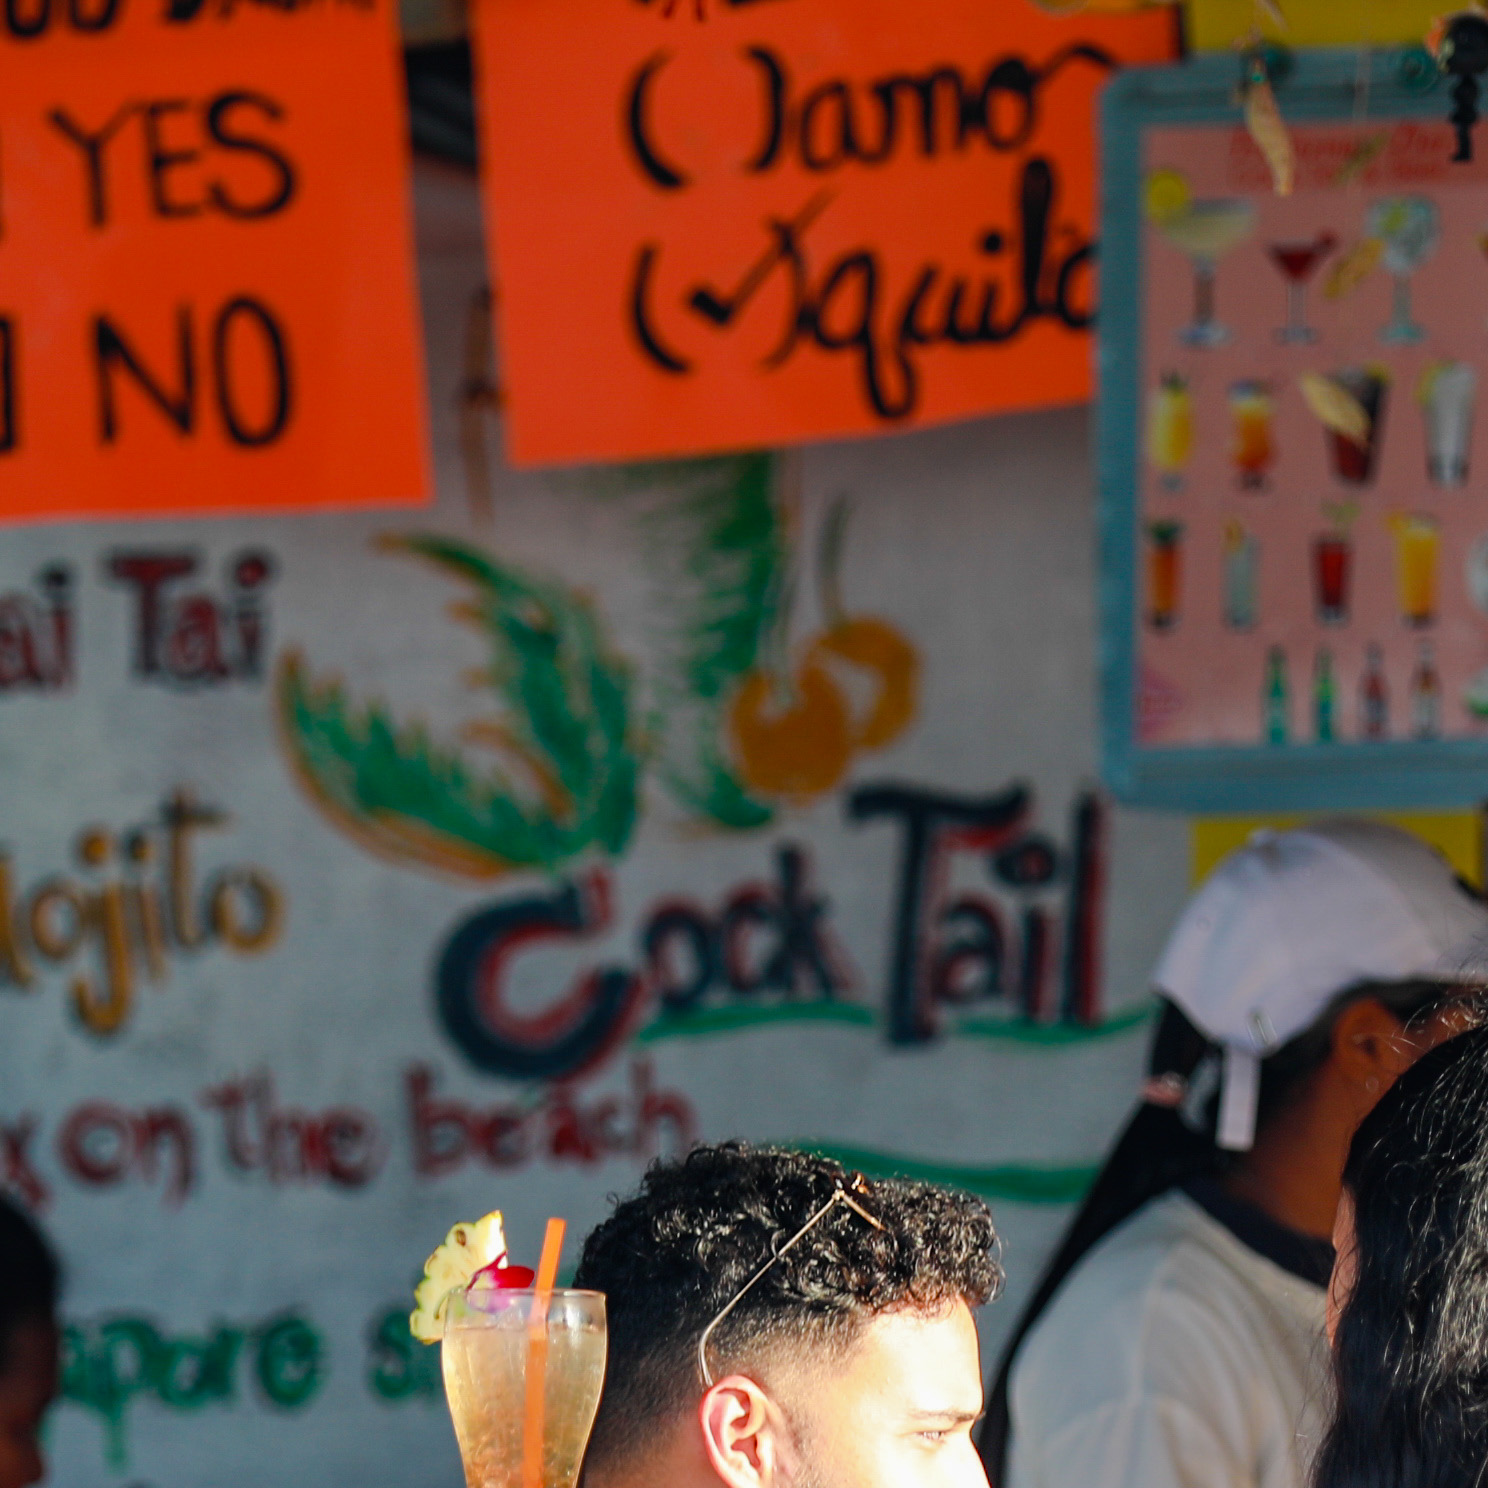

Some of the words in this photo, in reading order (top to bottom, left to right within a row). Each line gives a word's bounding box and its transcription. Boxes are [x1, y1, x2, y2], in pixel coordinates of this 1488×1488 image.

[45, 90, 297, 228] YES
[92, 296, 292, 448] NO
[104, 546, 273, 686] Tai
[57, 1100, 195, 1205] on
[201, 1070, 384, 1188] the
[404, 1061, 699, 1178] beach
